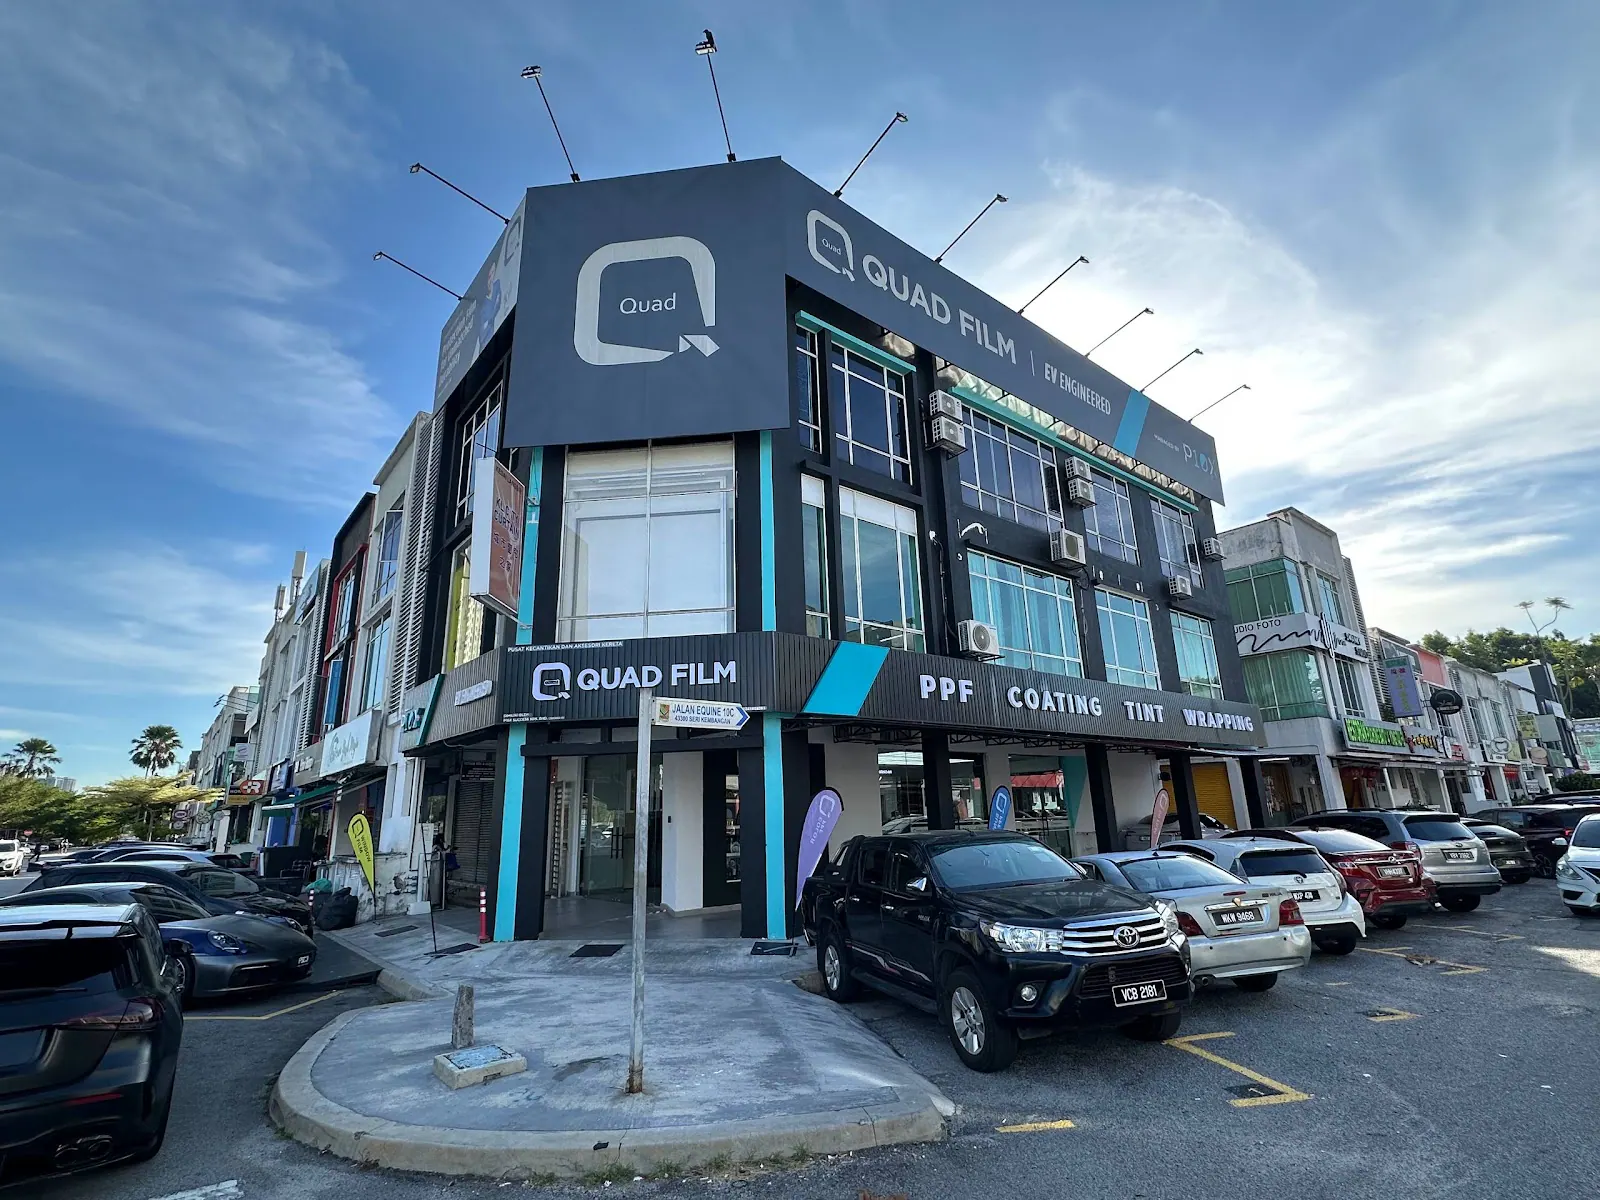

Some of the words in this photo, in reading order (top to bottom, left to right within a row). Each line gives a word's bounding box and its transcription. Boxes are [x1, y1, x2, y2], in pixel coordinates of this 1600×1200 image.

[822, 238, 842, 256] Quad
[619, 292, 677, 315] Quad
[862, 254, 951, 325] QUAD
[959, 309, 1017, 364] FILM
[1044, 362, 1058, 384] EV
[1059, 371, 1111, 416] ENGINEERED
[1256, 618, 1281, 630] FOTO
[525, 644, 561, 652] KECANTIKAN
[573, 641, 601, 649] AKSESORI
[601, 640, 624, 648] KERETA
[577, 665, 663, 691] QUAD
[671, 660, 737, 686] FILM
[672, 703, 695, 714] JALAN
[697, 705, 721, 717] EQUINE
[723, 706, 735, 718] 10C
[918, 673, 974, 703] PPF
[1007, 685, 1102, 717] COATING
[1123, 700, 1164, 723] TINT
[1182, 707, 1254, 732] WRAPPING
[700, 717, 731, 725] KEMBANGAN
[1120, 987, 1139, 1002] VCB
[1139, 984, 1158, 999] 2181
